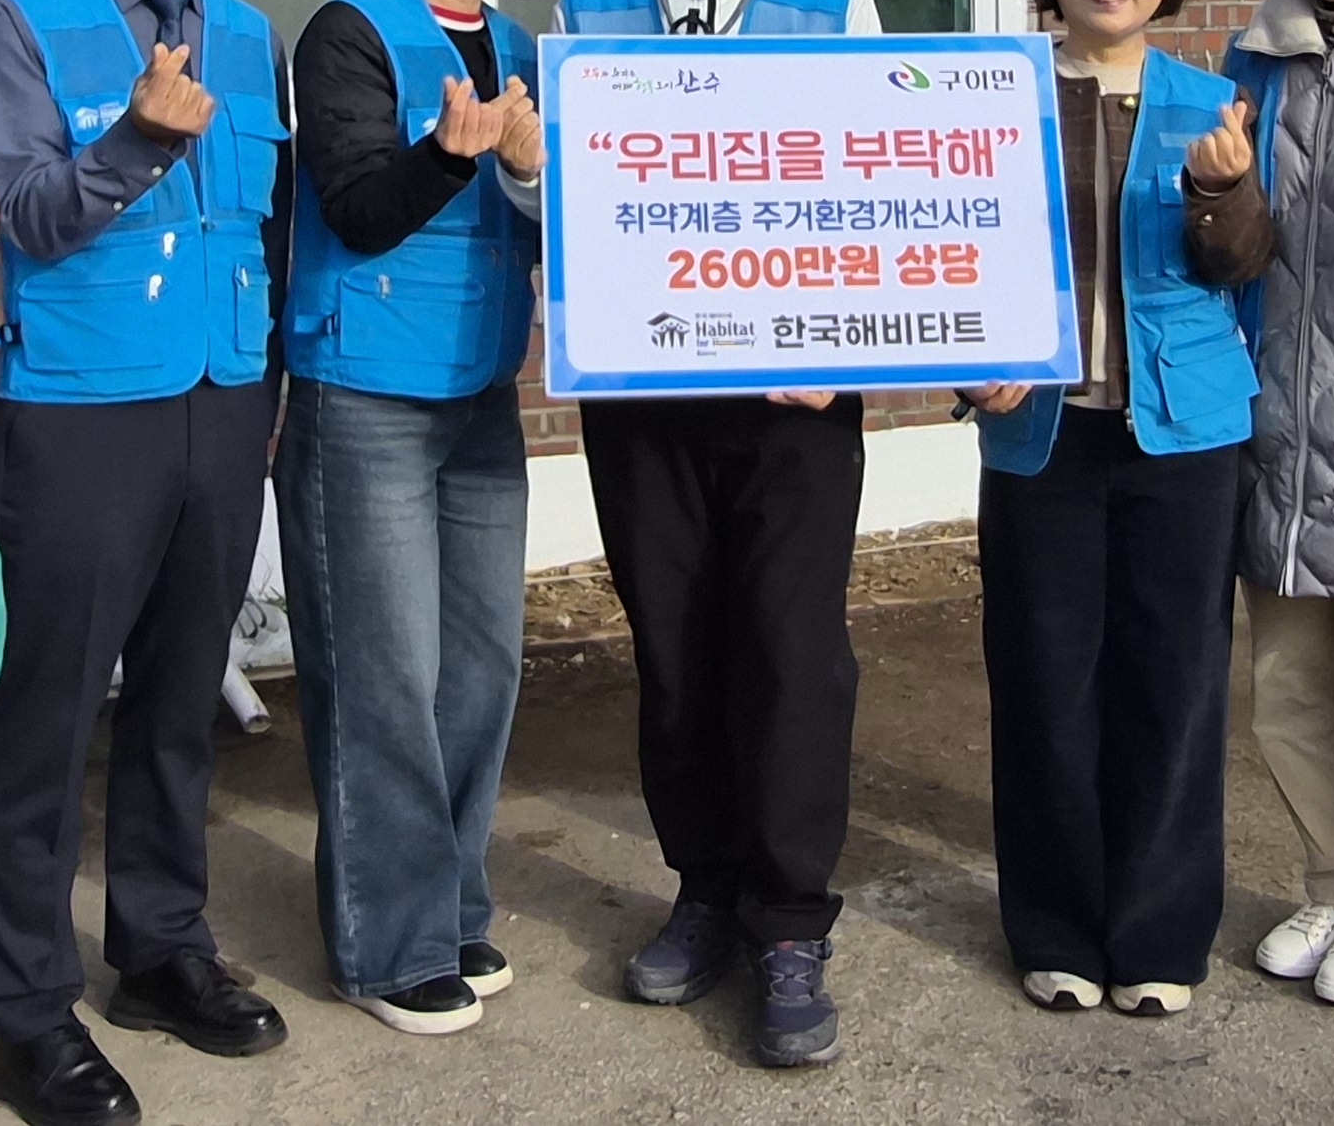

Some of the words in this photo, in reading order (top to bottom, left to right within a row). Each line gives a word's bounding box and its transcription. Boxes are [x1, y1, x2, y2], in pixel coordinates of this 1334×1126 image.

[675, 68, 720, 94] 완주
[938, 69, 1015, 91] 구이면
[588, 130, 825, 183] “우리집을
[842, 127, 1019, 180] 부탁해”
[615, 201, 742, 234] 취약계층
[752, 198, 1001, 232] 주거환경개선사업
[667, 244, 881, 290] 2600만원
[895, 242, 979, 285] 상당
[696, 321, 755, 337] Habitat
[771, 311, 986, 348] 한국해비타트
